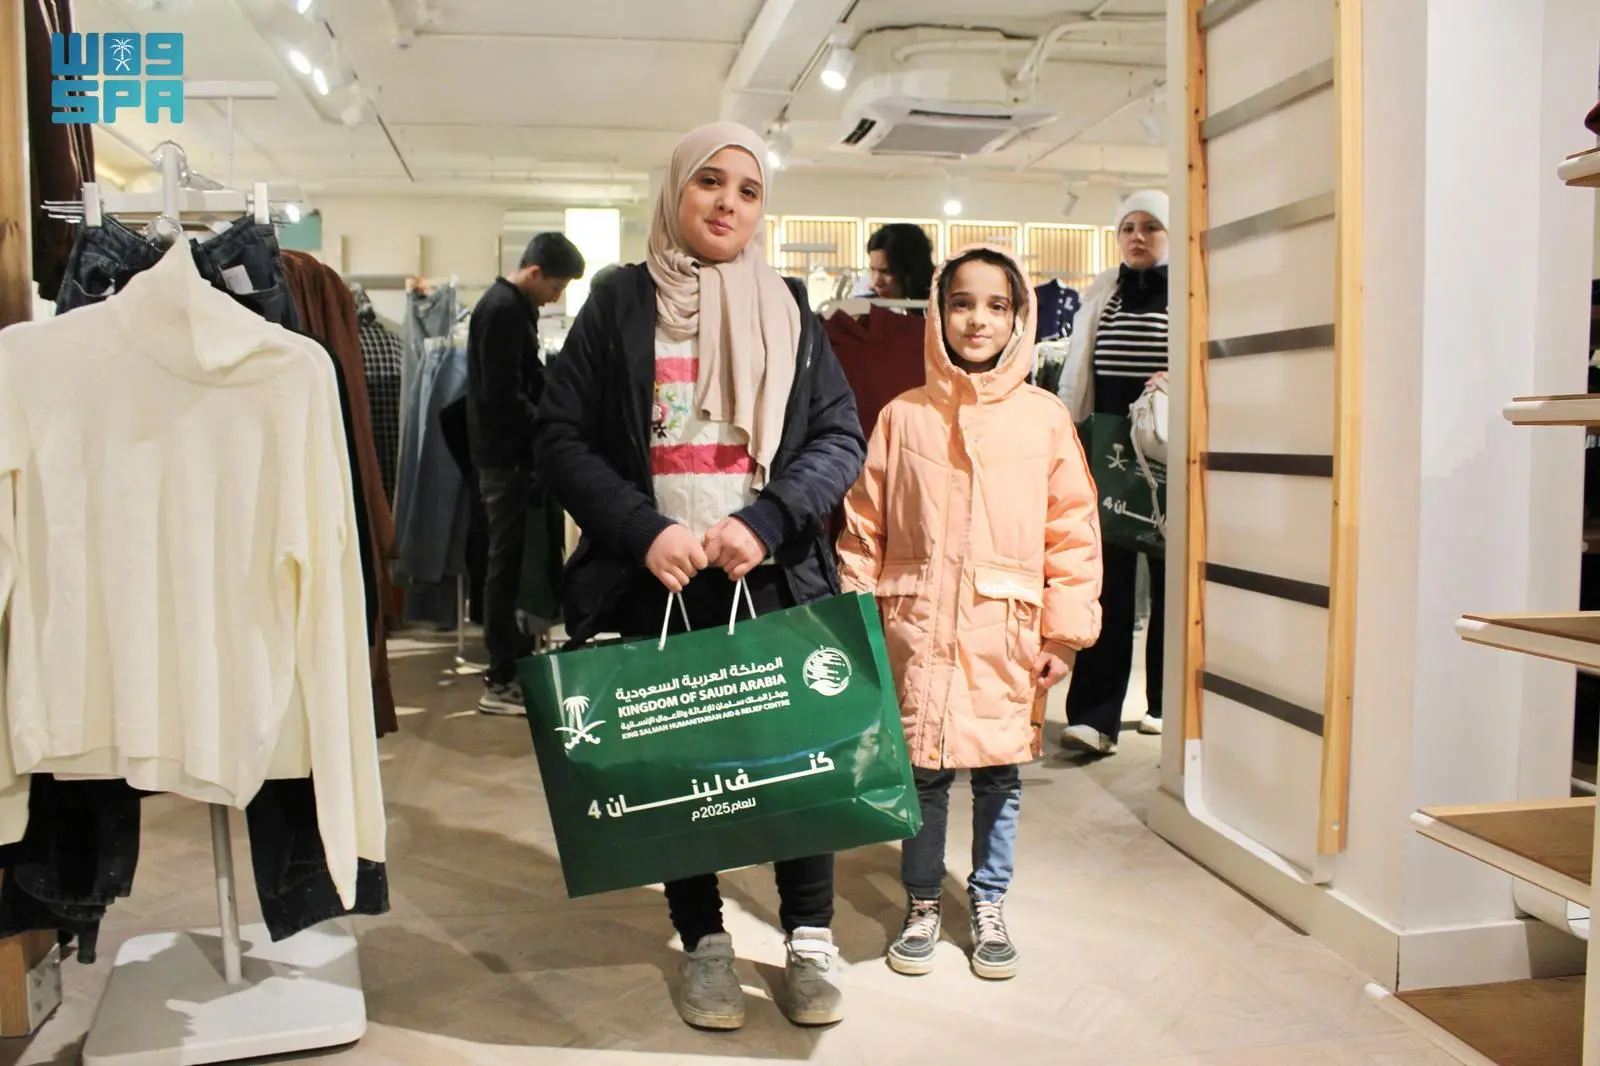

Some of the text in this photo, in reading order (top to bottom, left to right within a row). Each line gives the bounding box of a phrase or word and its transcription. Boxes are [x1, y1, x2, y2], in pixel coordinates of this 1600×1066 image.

[615, 656, 784, 703] المملكة العربية السعودية
[618, 673, 787, 718] KINGDOM OF SAUDI ARABIA
[621, 730, 639, 740] KING
[639, 724, 669, 736] SALMAN
[668, 712, 722, 730] HUMANITARIAN
[722, 710, 735, 719] AID
[740, 704, 763, 715] RELIEF
[763, 698, 791, 711] CENTRE
[587, 751, 835, 819] كنف لبنان 4
